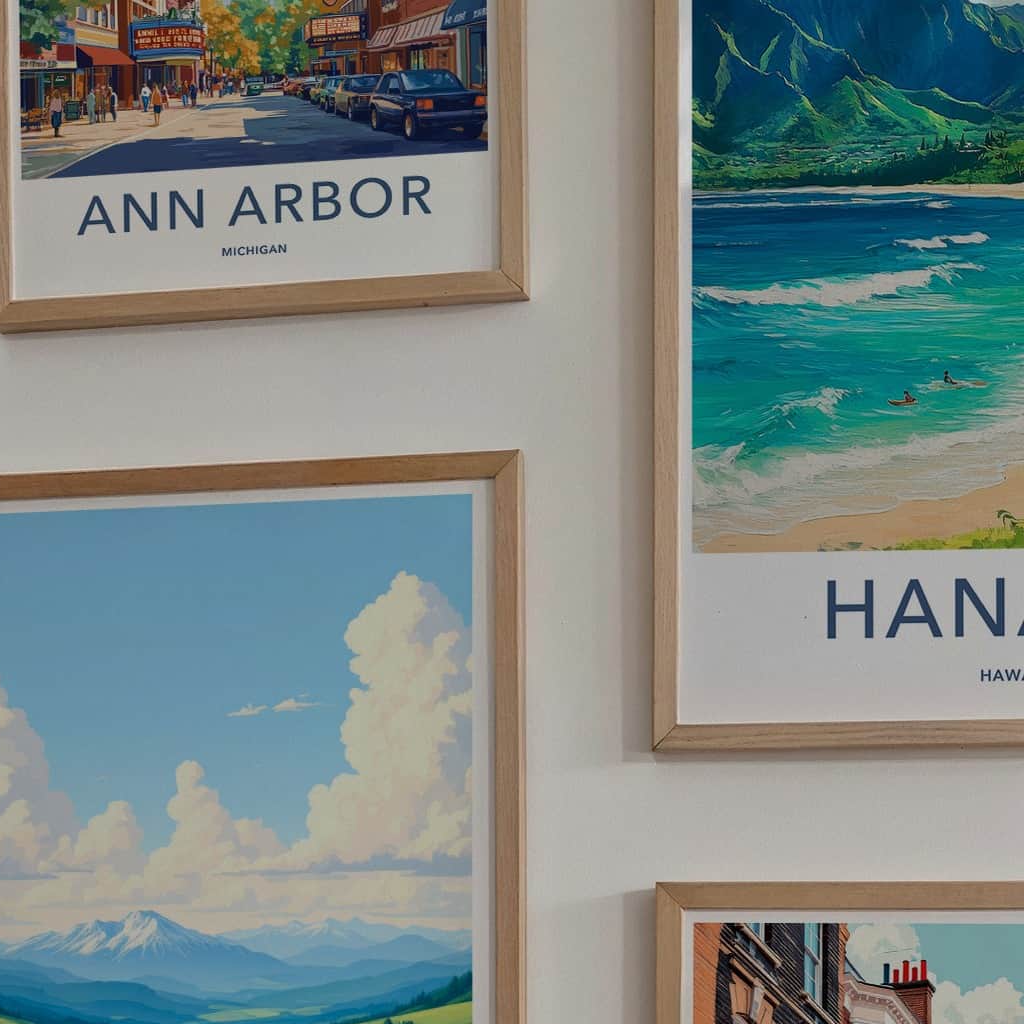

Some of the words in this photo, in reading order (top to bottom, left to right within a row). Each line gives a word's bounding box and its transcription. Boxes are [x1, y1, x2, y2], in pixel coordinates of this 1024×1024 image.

[77, 188, 204, 236] ANN
[228, 175, 432, 227] ARBOR
[221, 244, 288, 257] MICHIGAN
[827, 577, 1024, 639] HAN
[980, 668, 1024, 682] HAW
